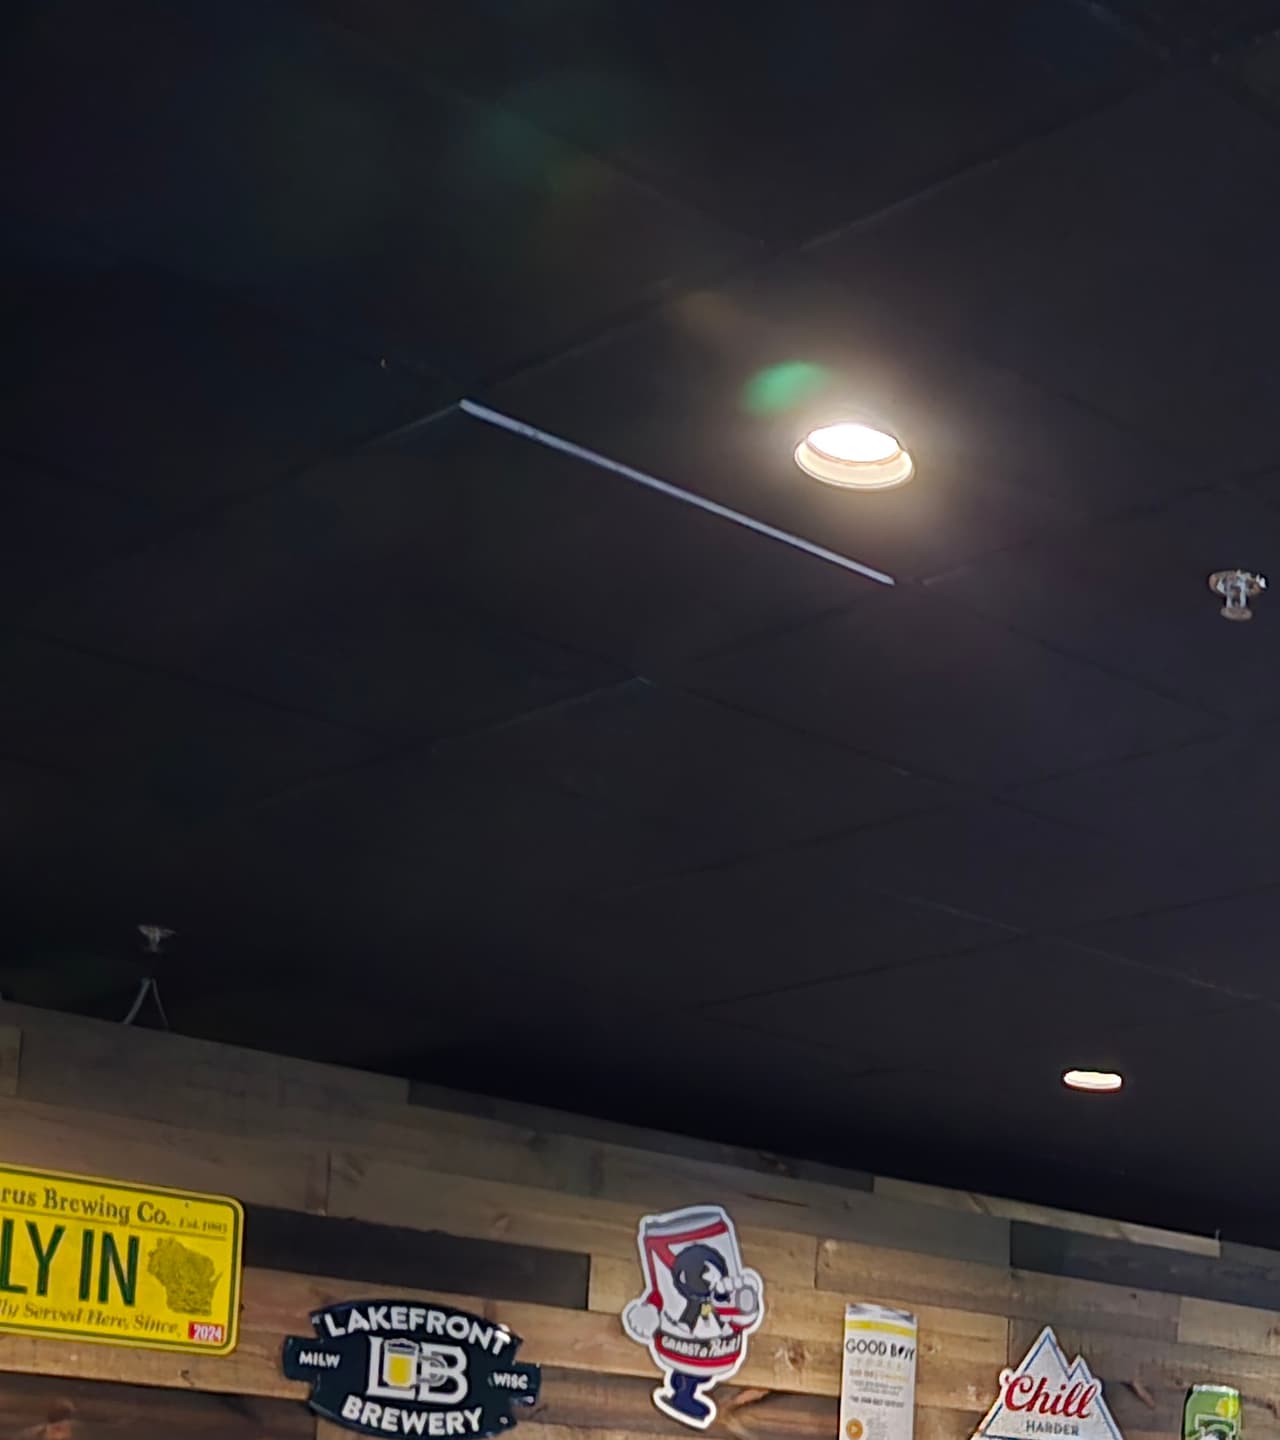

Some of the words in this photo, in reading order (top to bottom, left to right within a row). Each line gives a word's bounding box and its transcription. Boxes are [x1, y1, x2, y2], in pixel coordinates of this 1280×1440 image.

[43, 1187, 130, 1225] Brewing
[137, 1200, 170, 1226] Co.
[78, 1228, 140, 1307] IN
[23, 1301, 83, 1323] Served
[87, 1308, 130, 1331] Here,
[324, 1306, 512, 1355] LAKEFRONT
[193, 1323, 223, 1341] 2024
[846, 1338, 887, 1356] GOOD
[299, 1350, 341, 1369] MILW
[492, 1371, 529, 1391] WISC
[1004, 1374, 1098, 1419] Chill
[341, 1394, 483, 1436] BREWERY
[1025, 1420, 1080, 1436] HARDER
